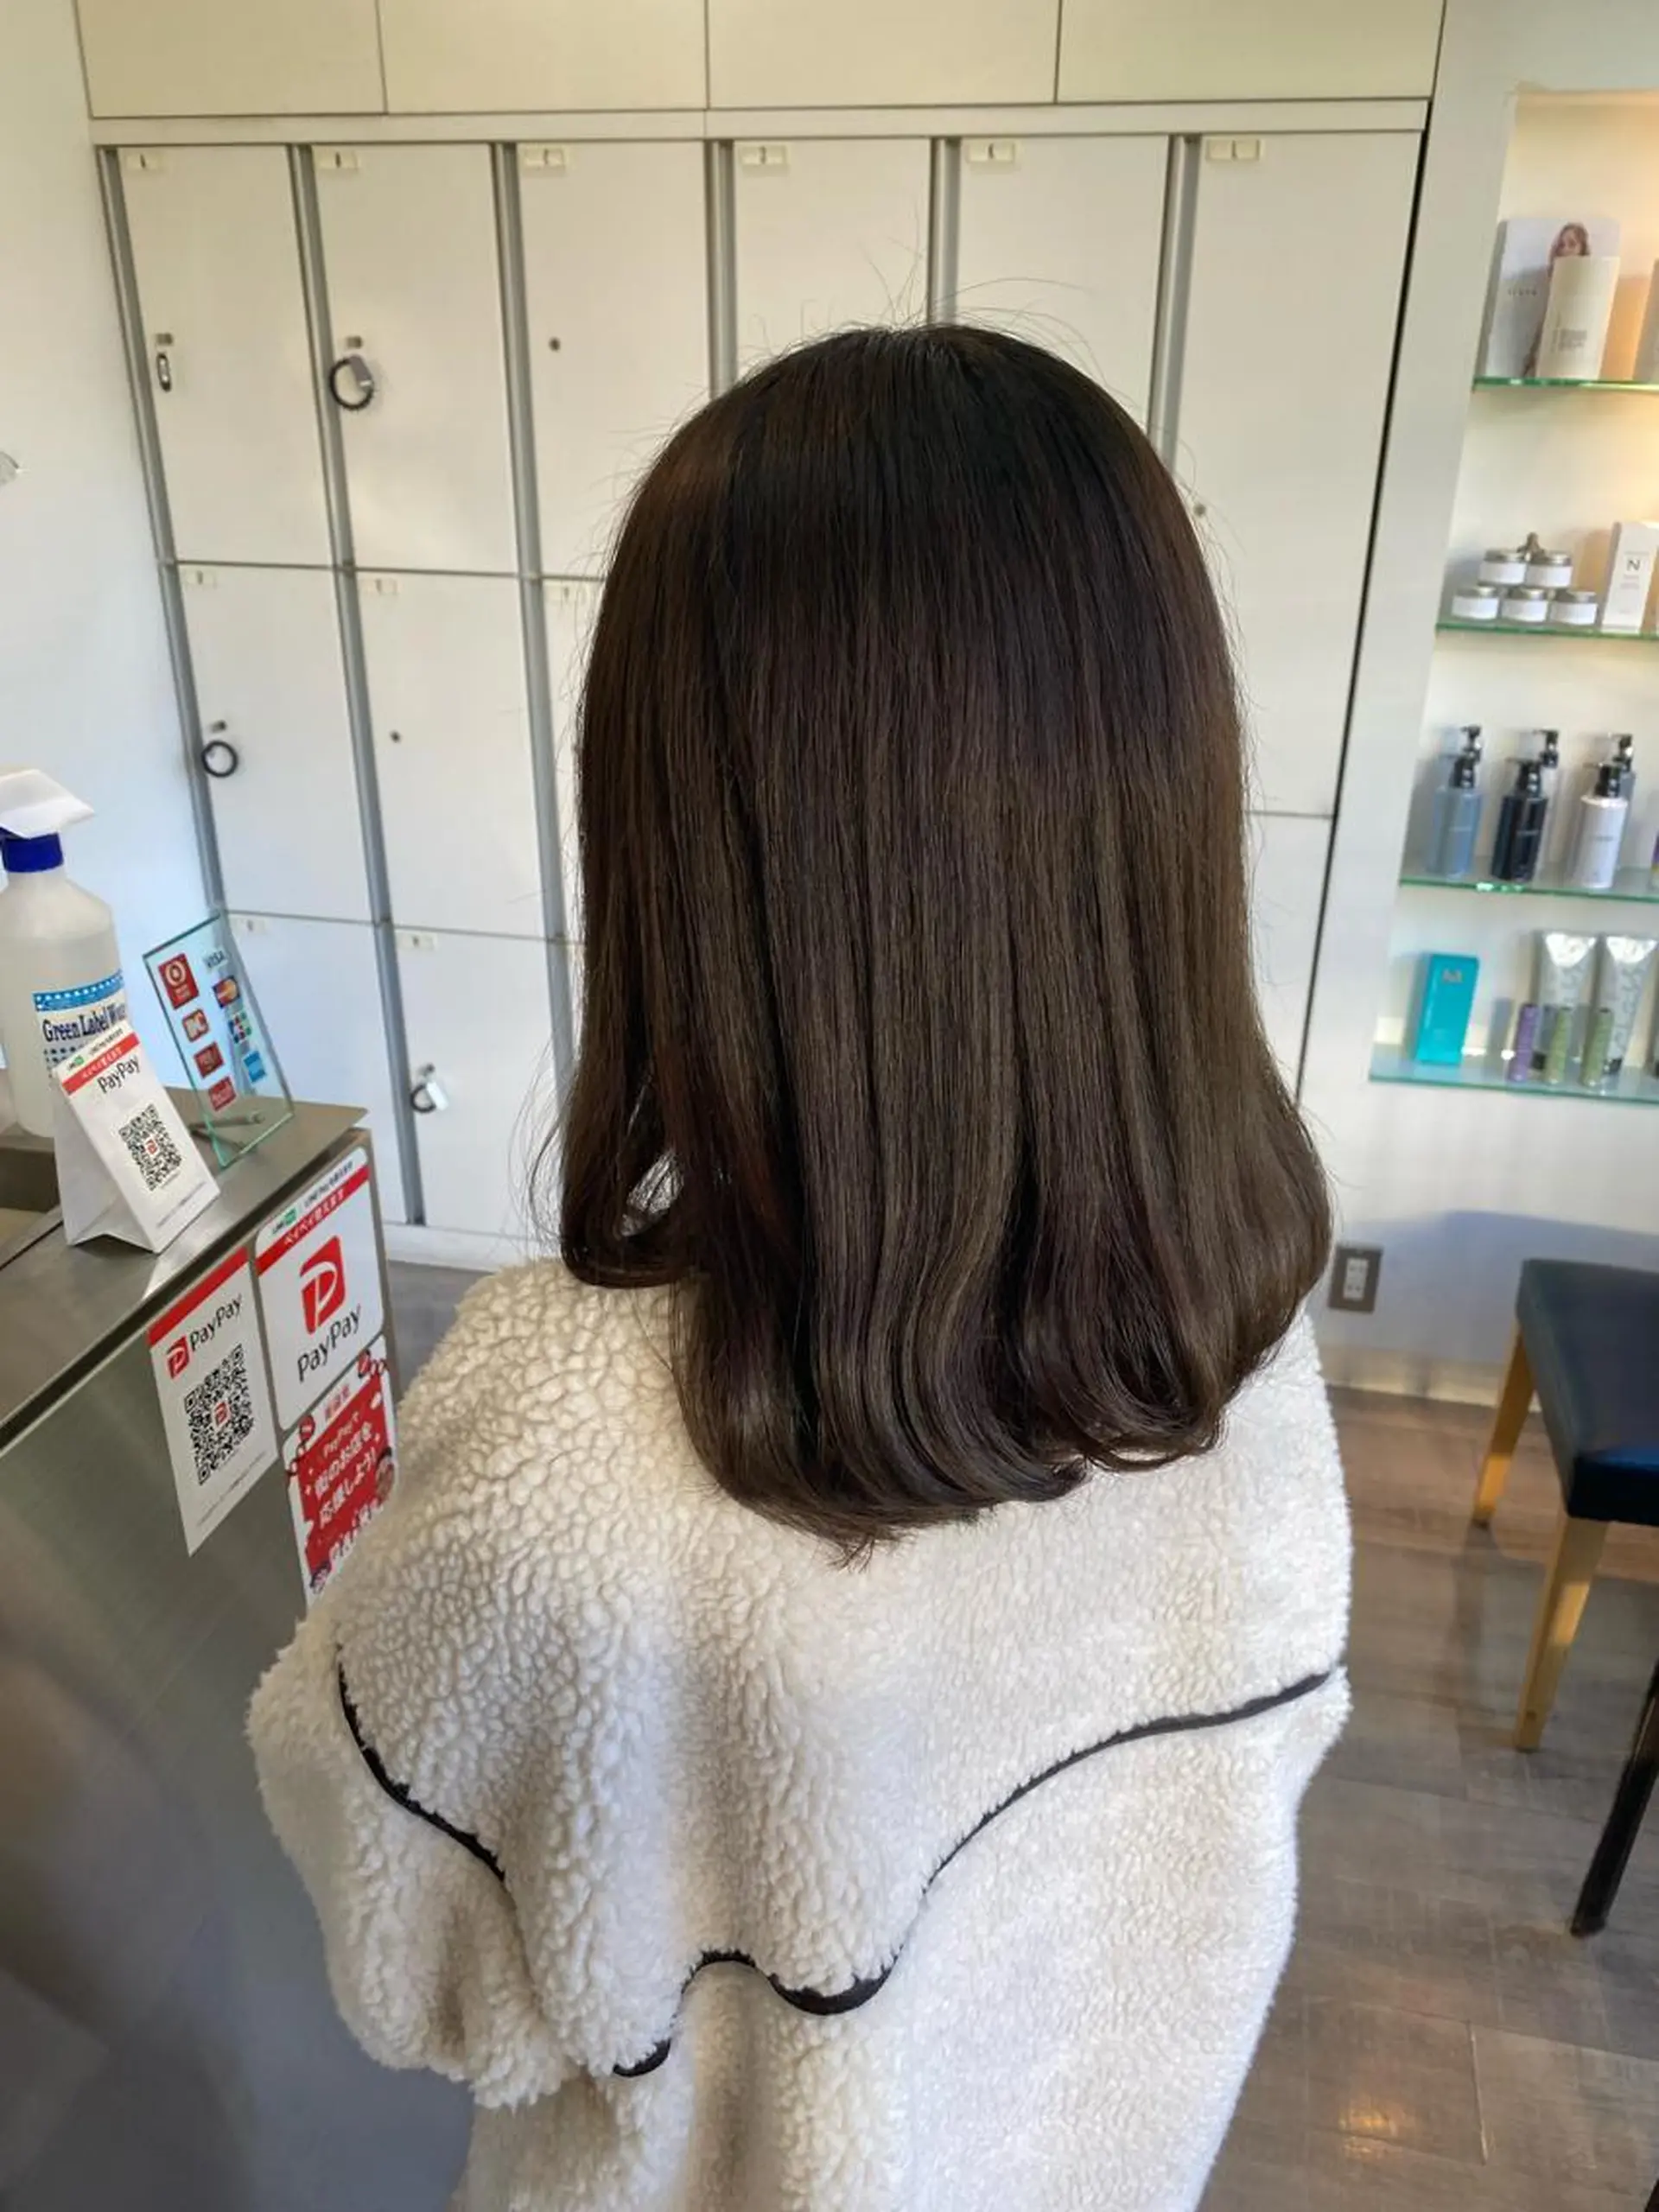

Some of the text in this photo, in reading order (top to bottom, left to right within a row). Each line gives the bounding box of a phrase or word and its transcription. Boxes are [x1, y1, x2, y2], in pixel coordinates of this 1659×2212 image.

[42, 1018, 81, 1042] Green
[79, 1006, 111, 1036] Label
[97, 1055, 140, 1094] PayPay
[189, 1294, 243, 1352] PayPay
[296, 1303, 361, 1382] PayPay
